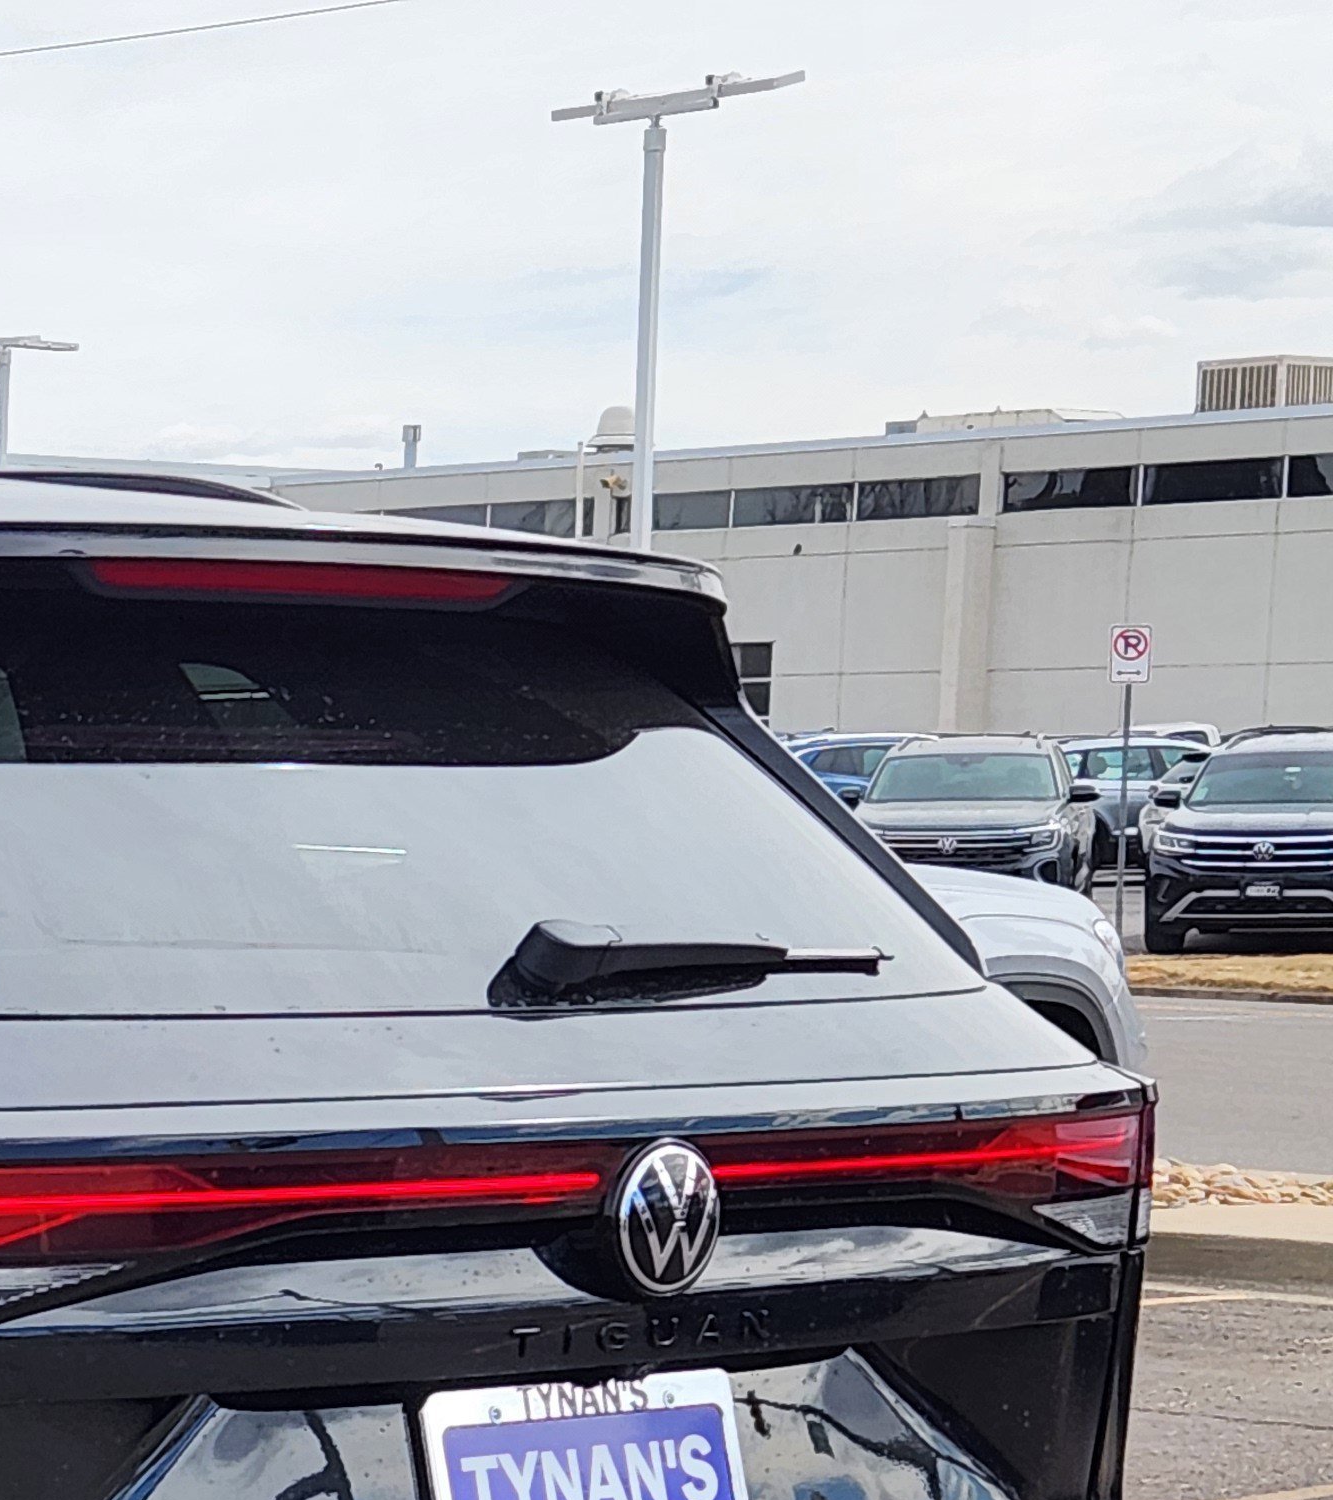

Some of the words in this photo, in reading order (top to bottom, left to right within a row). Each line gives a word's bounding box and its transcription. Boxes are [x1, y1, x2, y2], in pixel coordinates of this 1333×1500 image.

[626, 1145, 716, 1287] VW
[509, 1309, 771, 1357] TIGUAN
[516, 1378, 649, 1420] TYNAN'S
